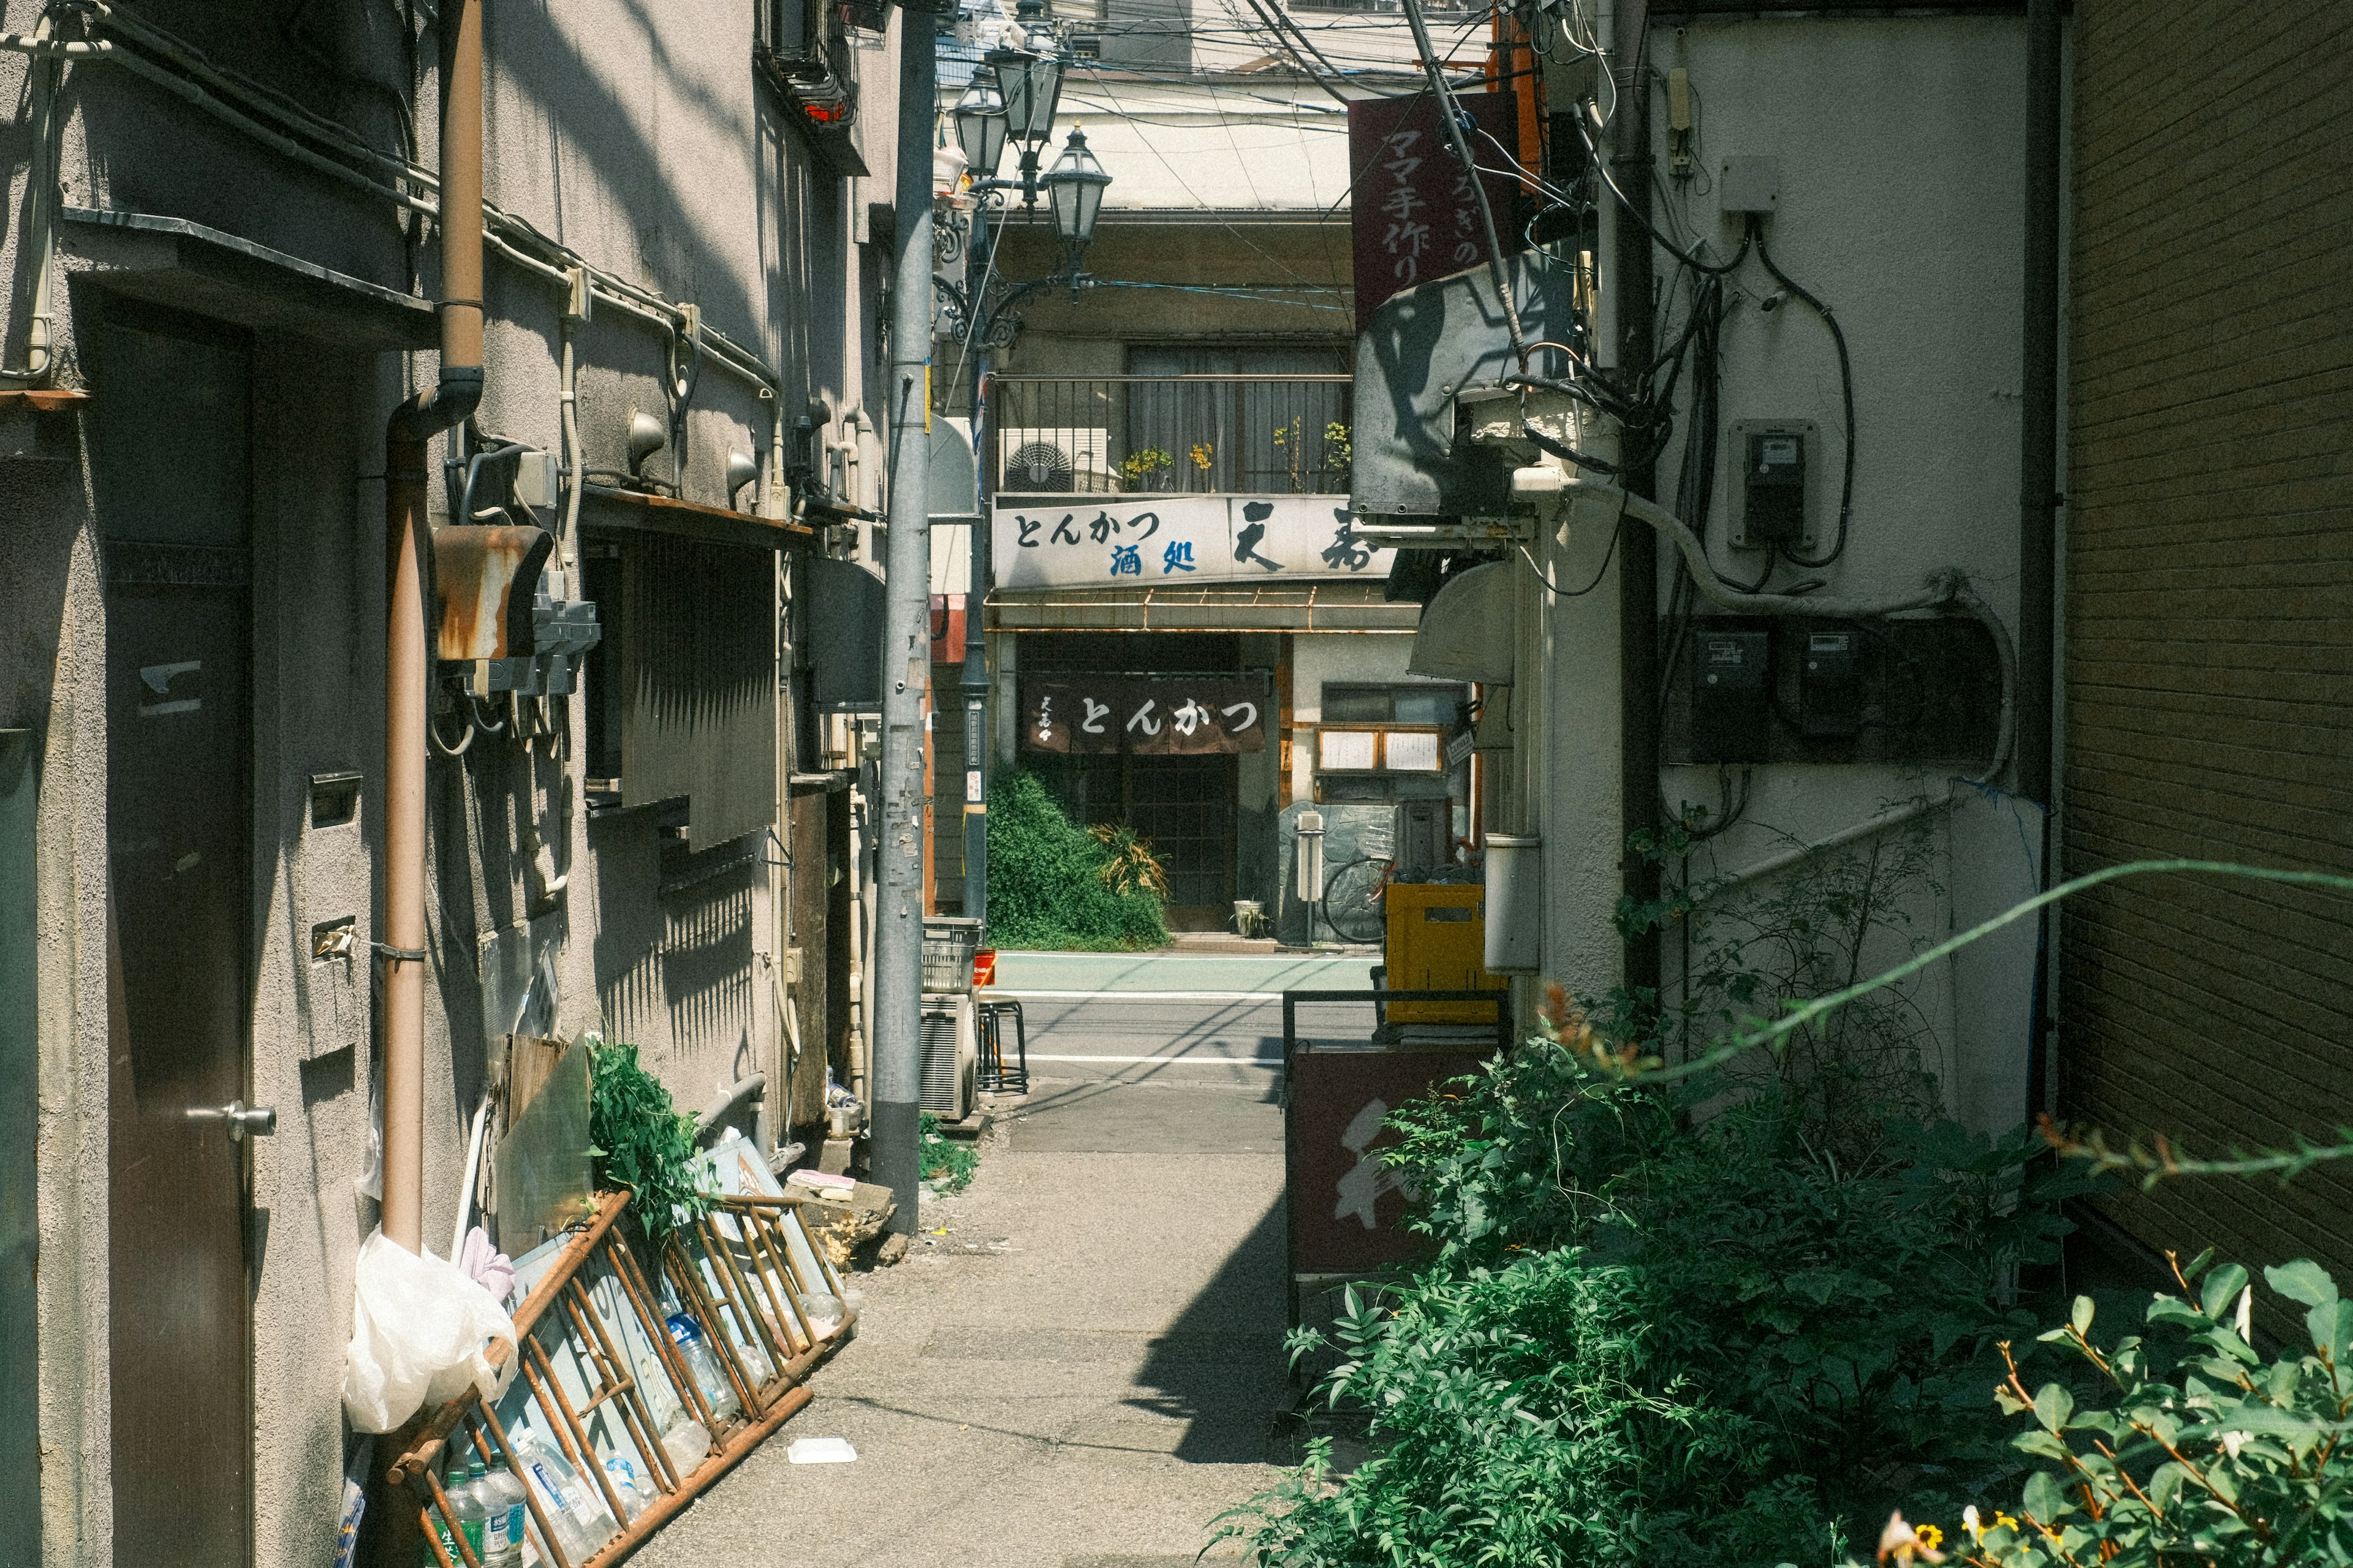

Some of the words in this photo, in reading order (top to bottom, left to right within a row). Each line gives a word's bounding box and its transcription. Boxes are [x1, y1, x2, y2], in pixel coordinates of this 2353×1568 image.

[1381, 130, 1430, 286] ママ手作り
[1015, 510, 1159, 548] とんかつ
[1110, 540, 1197, 577] 酒処
[1082, 697, 1257, 737] とんかつ
[1450, 735, 1470, 754] CLOSED
[494, 1531, 507, 1540] GREE
